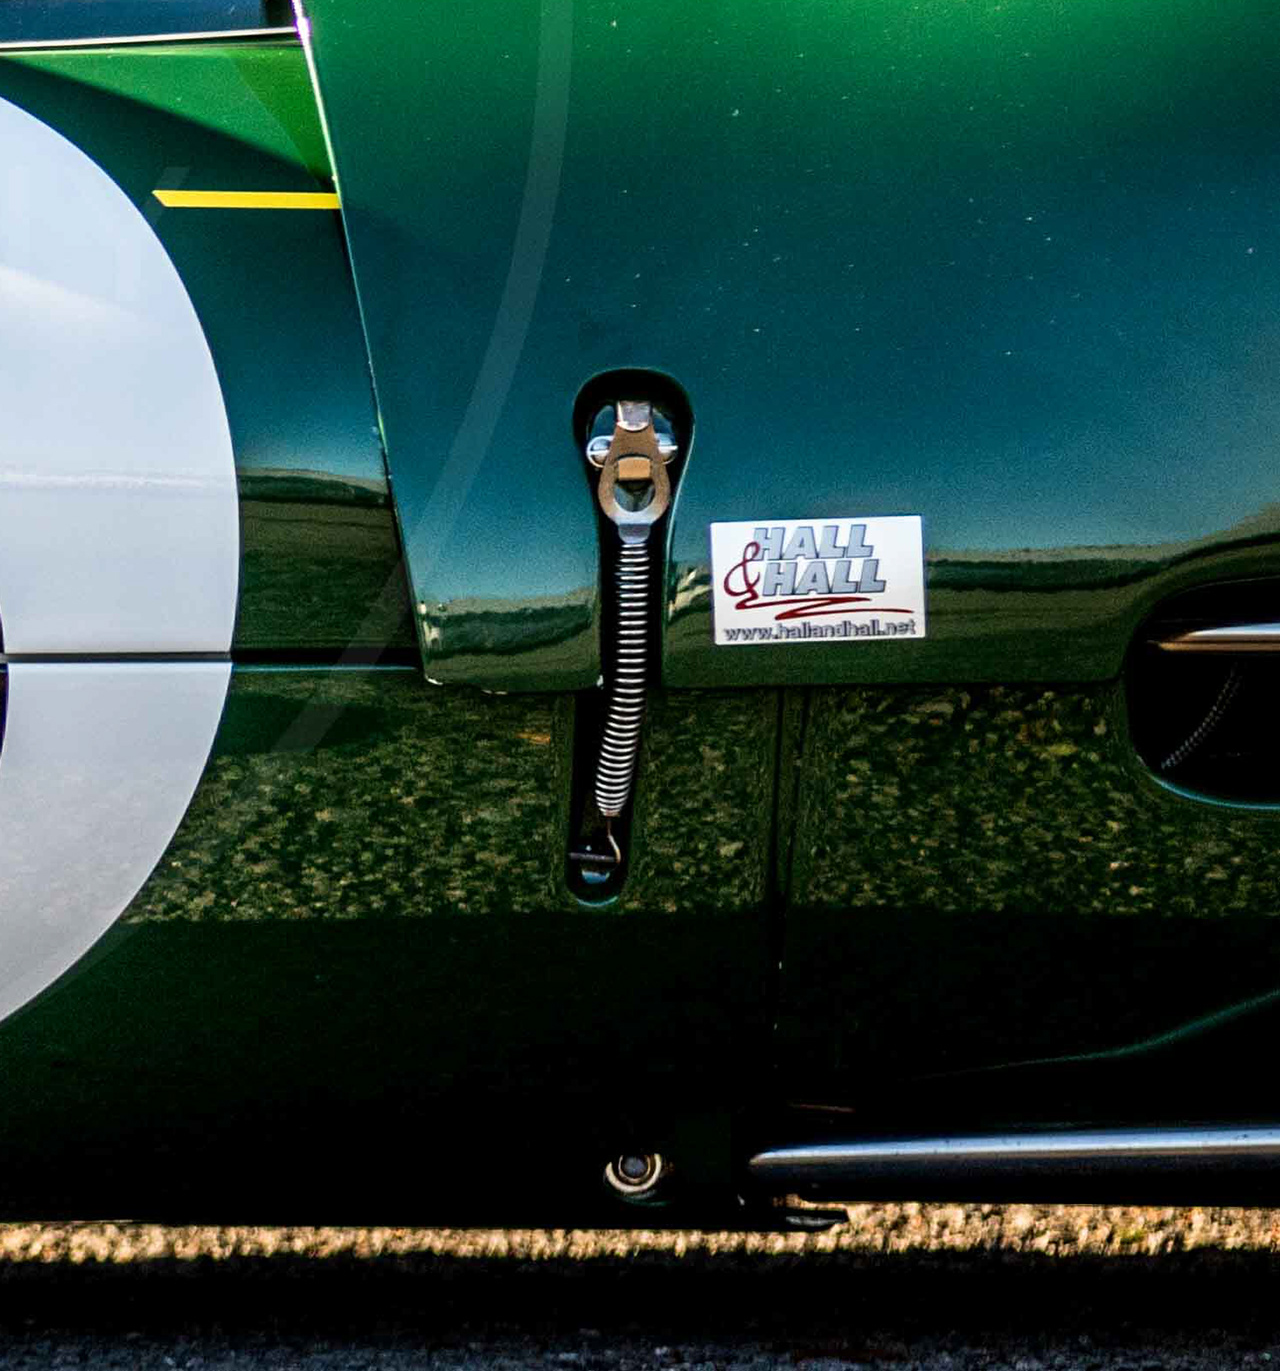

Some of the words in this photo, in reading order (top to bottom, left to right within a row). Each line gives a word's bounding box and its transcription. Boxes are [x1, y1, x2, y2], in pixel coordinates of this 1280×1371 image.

[752, 523, 875, 562] HALL
[723, 541, 761, 598] &
[761, 559, 888, 597] HALL
[723, 618, 917, 642] www.hallandhall.net
